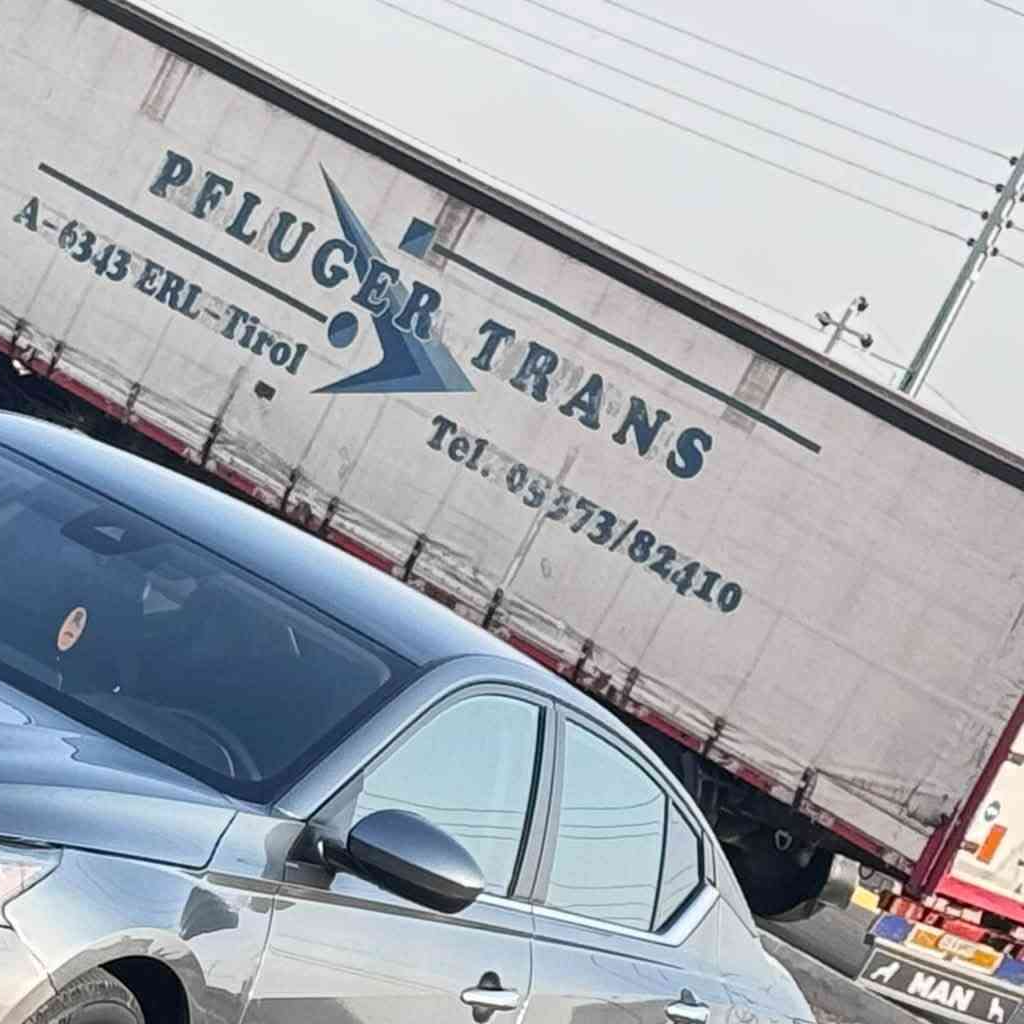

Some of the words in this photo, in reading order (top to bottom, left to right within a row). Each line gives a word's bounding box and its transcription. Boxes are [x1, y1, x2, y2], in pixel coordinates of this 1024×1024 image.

[13, 196, 131, 281] A-6343
[135, 259, 308, 375] ERL-Tirol
[149, 150, 442, 339] PFLUGER
[471, 320, 713, 479] TRANS
[427, 415, 489, 476] Tel.
[907, 972, 975, 1012] MAN
